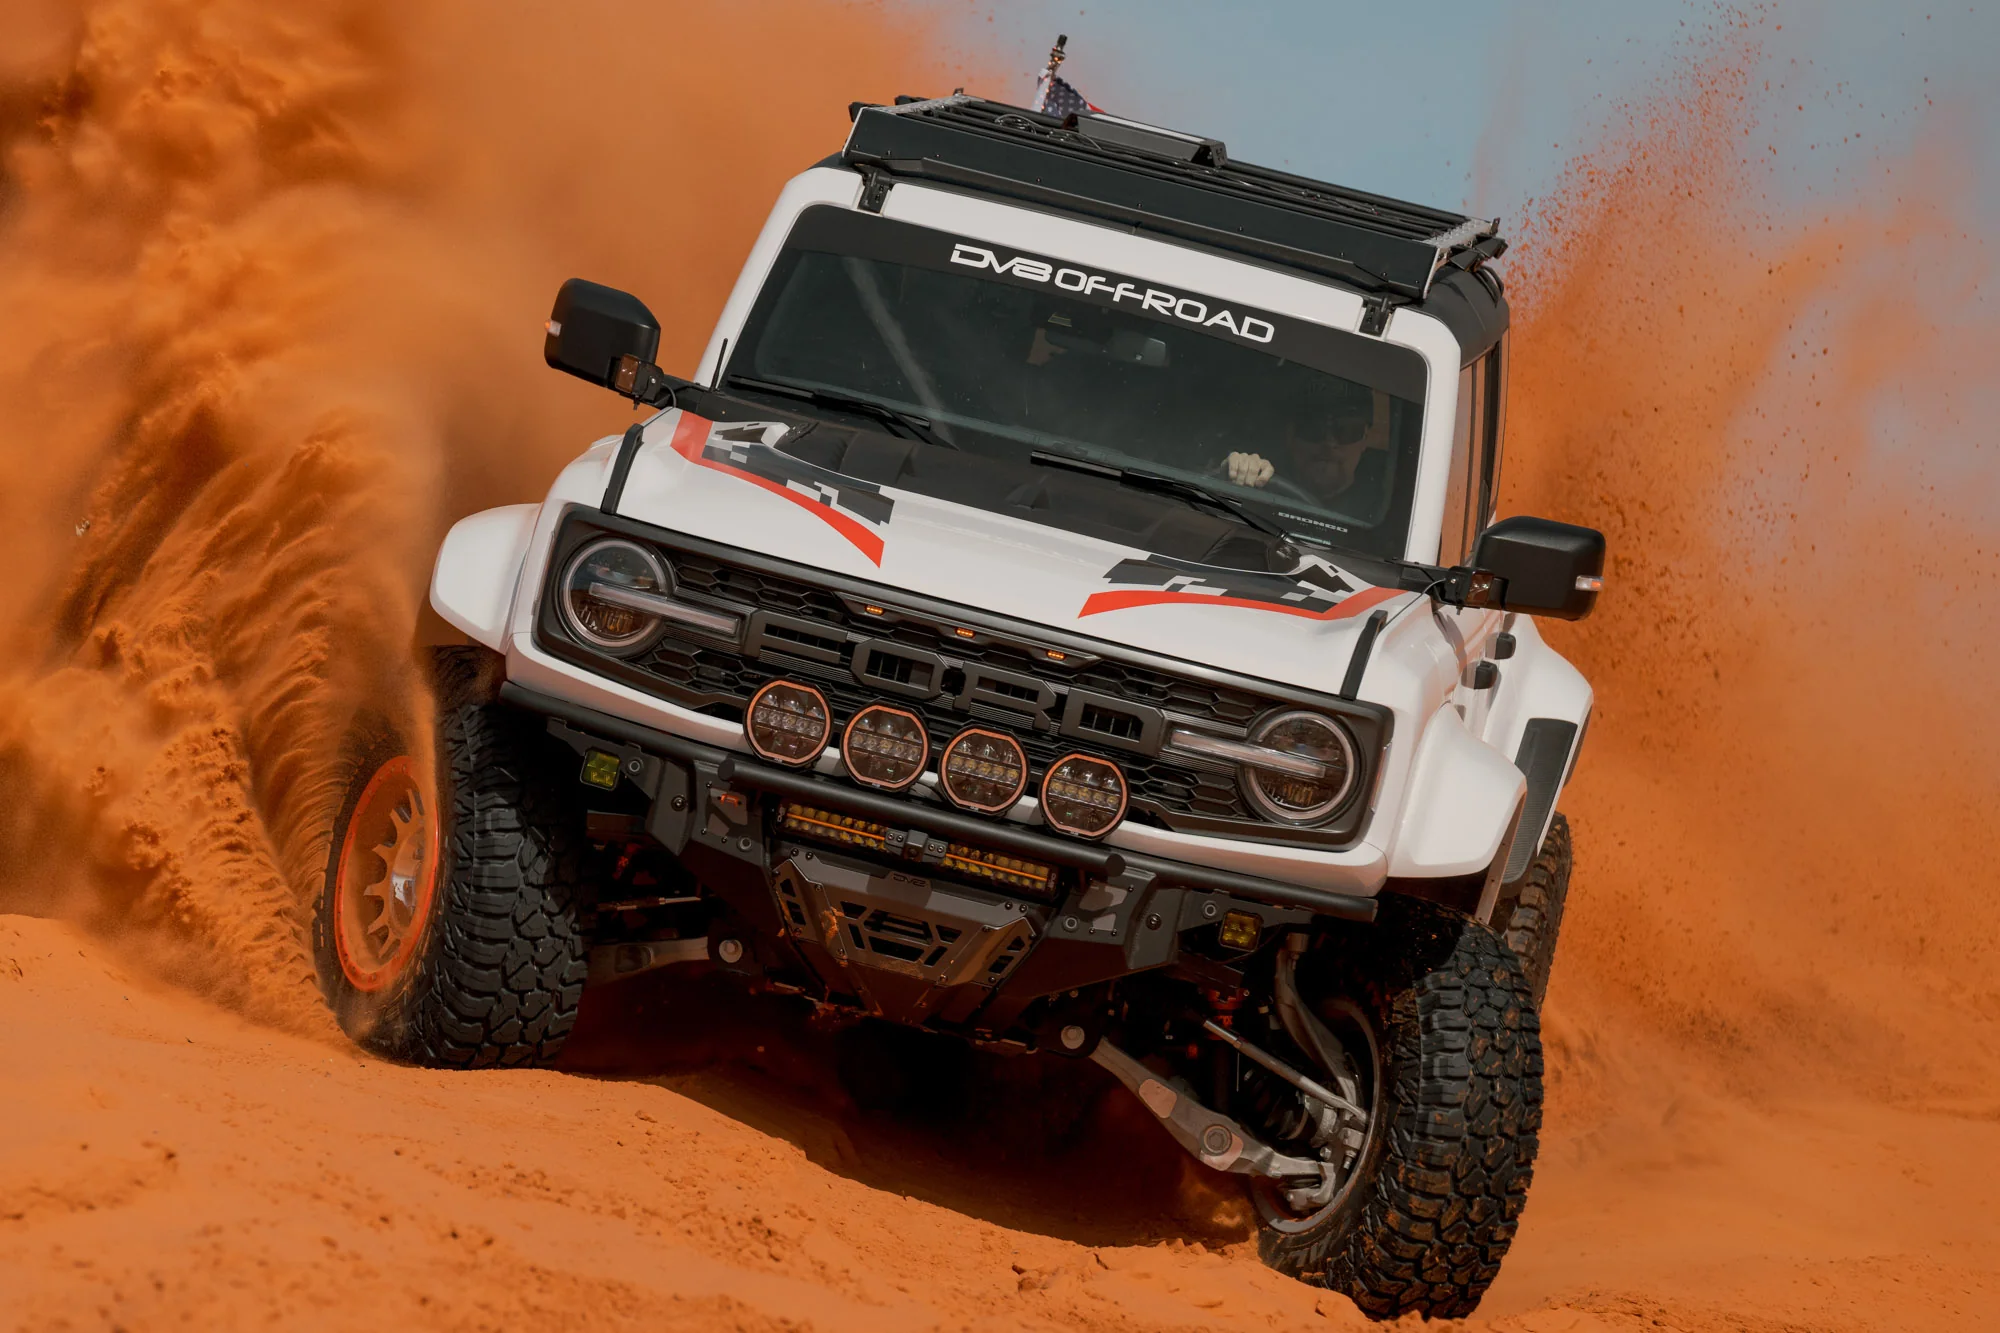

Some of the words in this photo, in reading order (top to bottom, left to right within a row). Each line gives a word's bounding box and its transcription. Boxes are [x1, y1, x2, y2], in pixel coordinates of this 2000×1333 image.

[950, 243, 1051, 283] DV8
[1054, 269, 1275, 344] OFFROAD
[741, 609, 1166, 758] FORD
